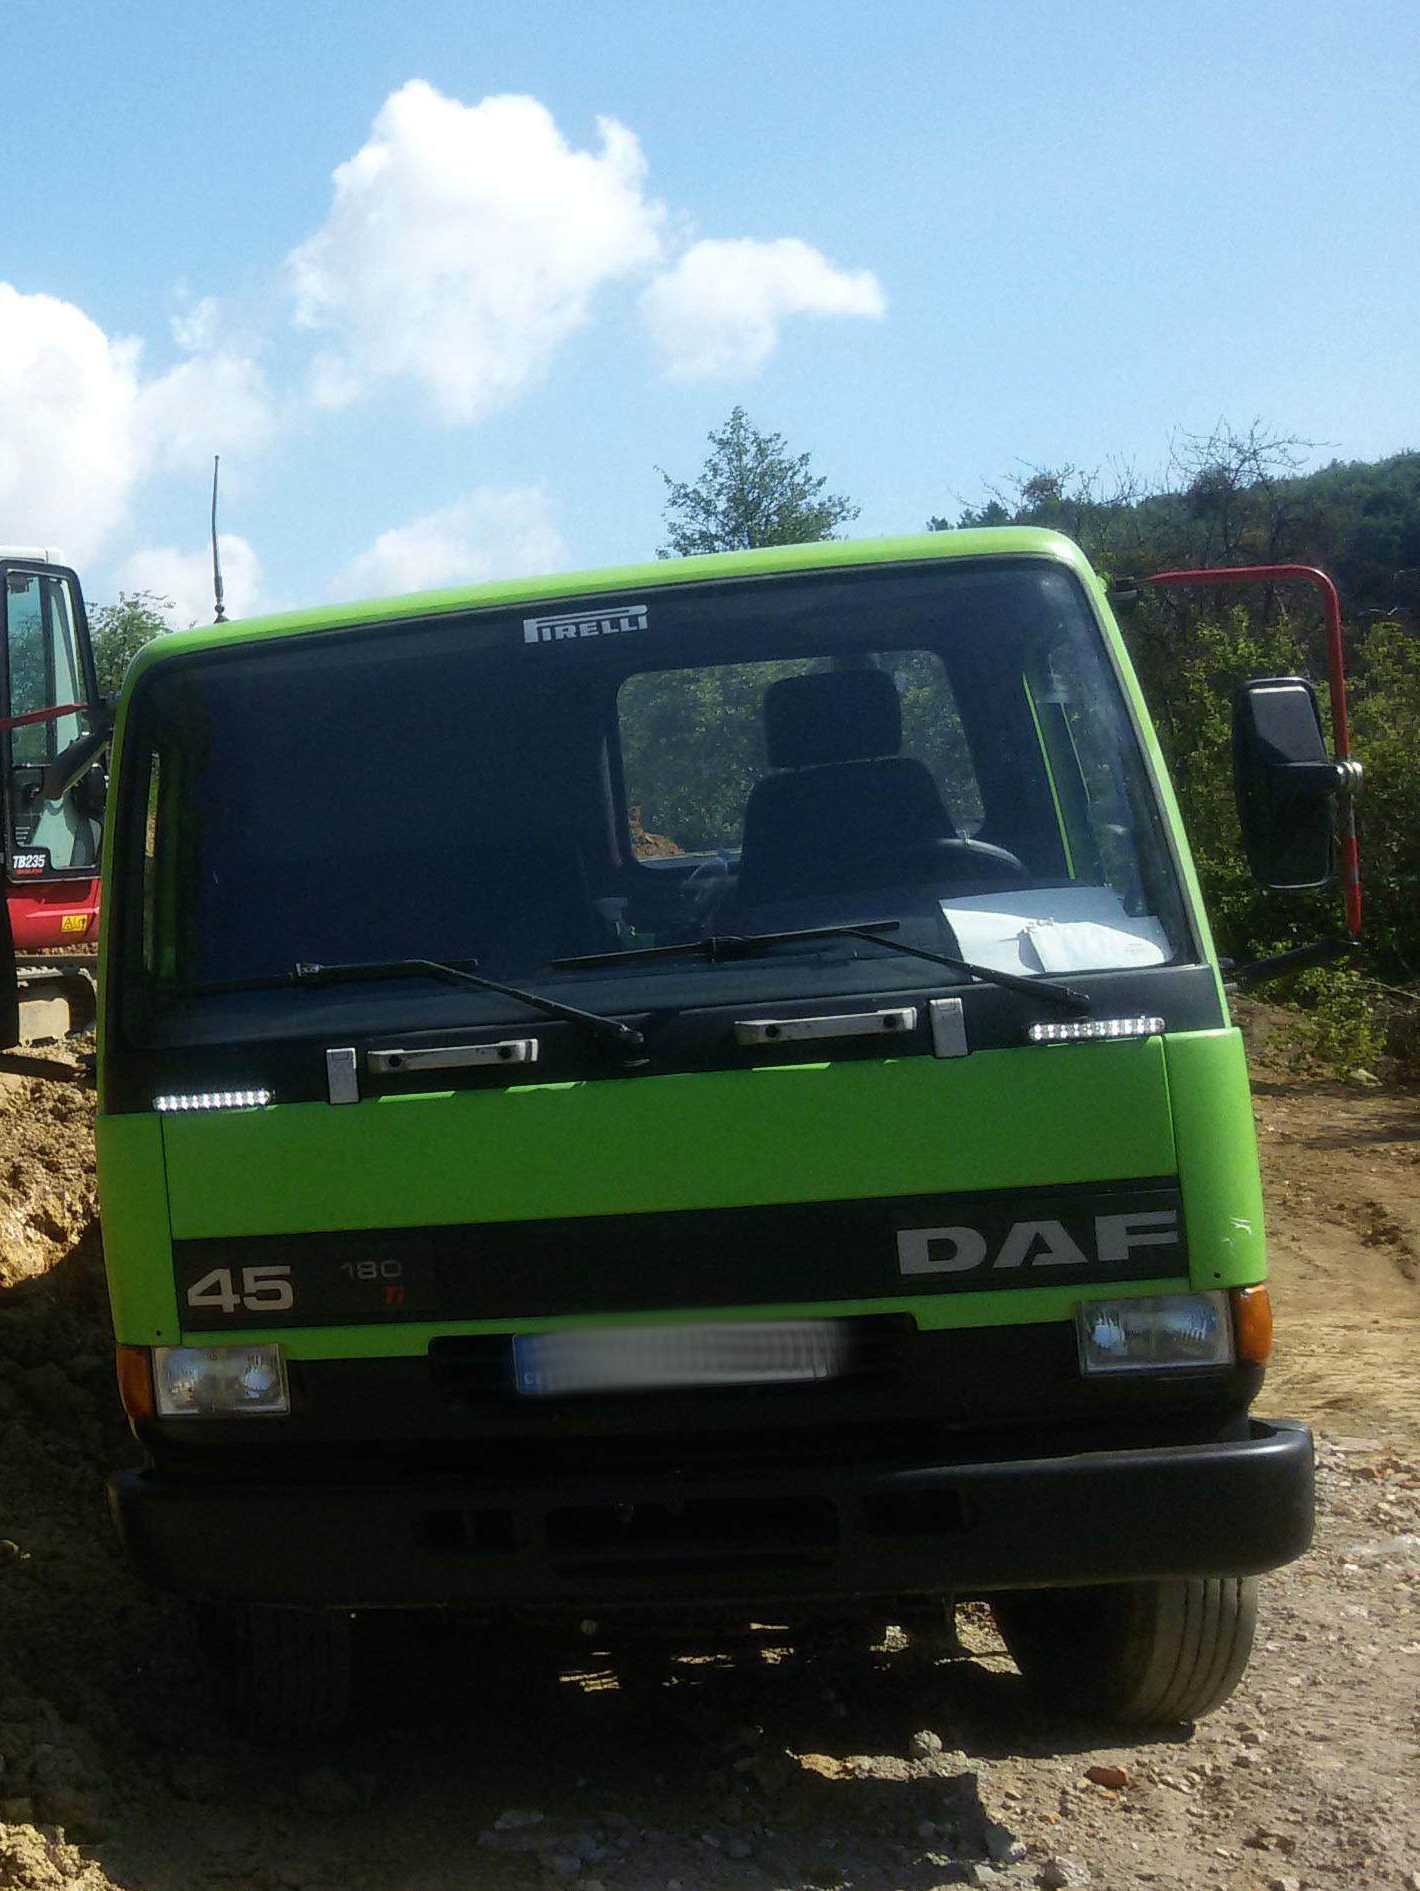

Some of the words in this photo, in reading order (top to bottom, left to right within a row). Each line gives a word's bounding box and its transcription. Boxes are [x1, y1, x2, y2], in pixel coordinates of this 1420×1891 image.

[523, 605, 648, 643] PIRELLI
[13, 855, 46, 868] TB235
[897, 1210, 1179, 1275] DAF
[187, 1266, 294, 1313] 45
[341, 1260, 402, 1279] 180
